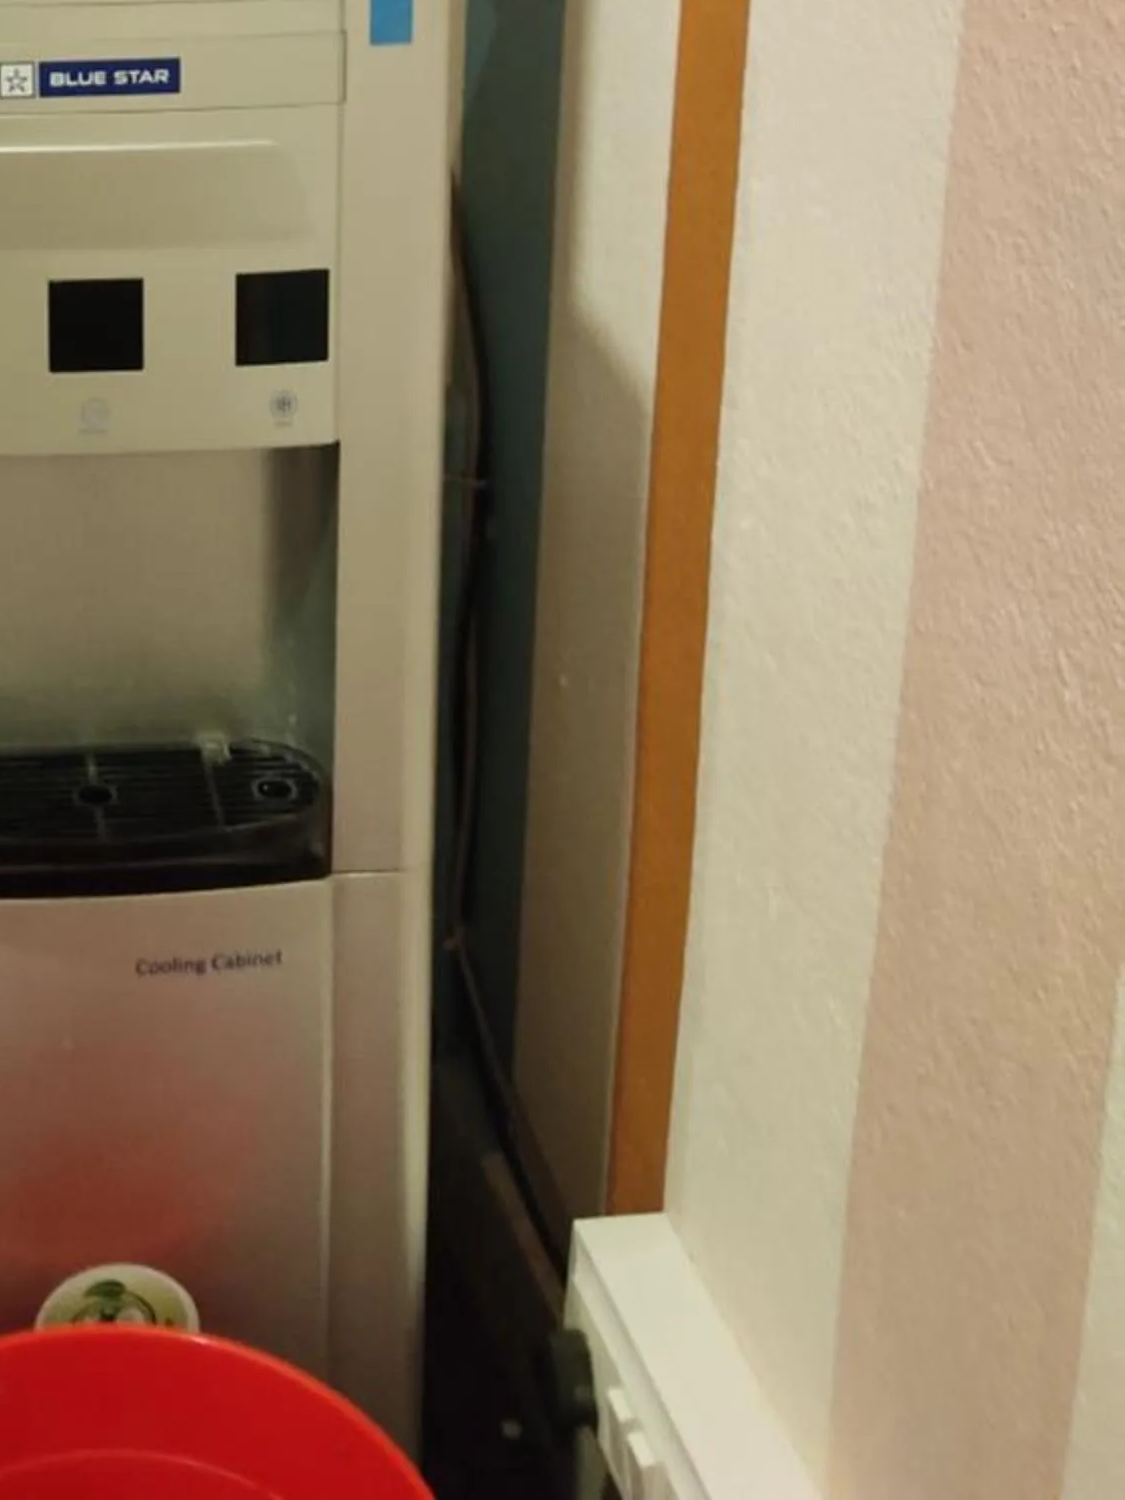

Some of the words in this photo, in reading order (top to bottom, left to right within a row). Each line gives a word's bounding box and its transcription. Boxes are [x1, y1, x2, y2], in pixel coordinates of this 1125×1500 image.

[50, 70, 107, 87] BLUE
[114, 68, 169, 85] STAR
[135, 958, 206, 976] Cooling
[212, 950, 282, 971] Cabinet
